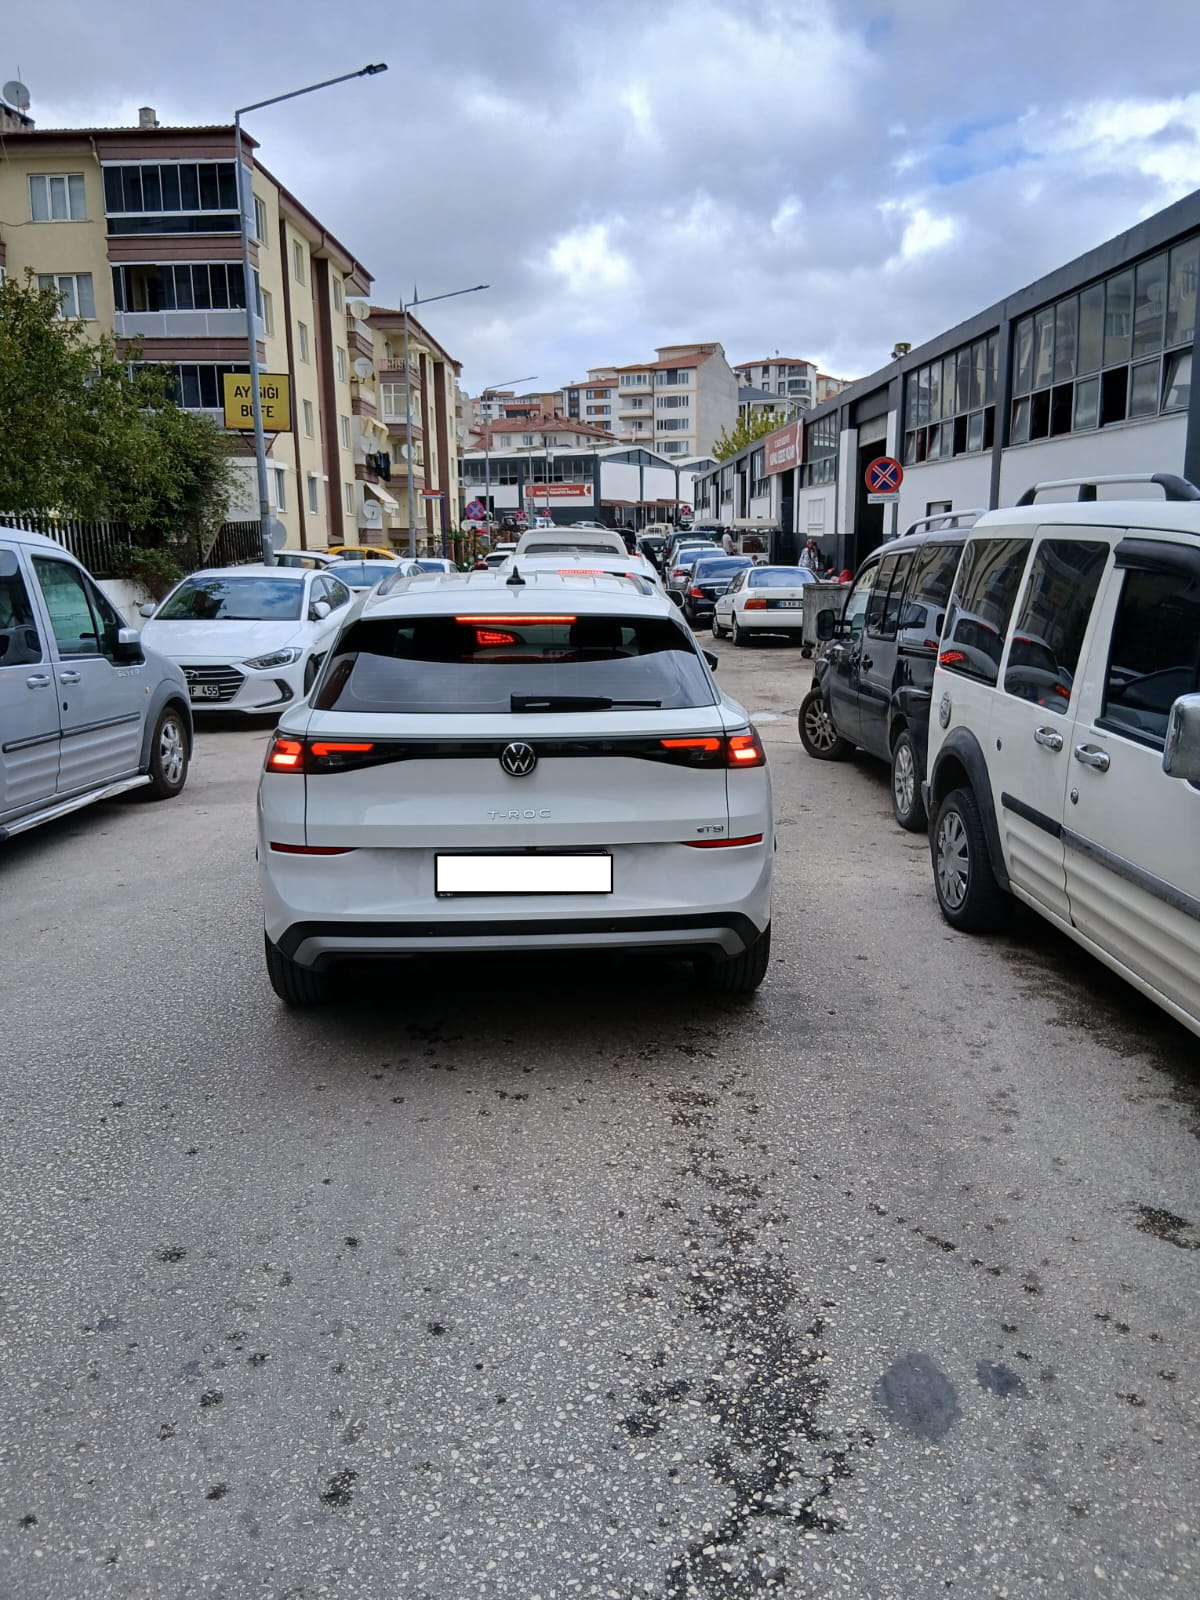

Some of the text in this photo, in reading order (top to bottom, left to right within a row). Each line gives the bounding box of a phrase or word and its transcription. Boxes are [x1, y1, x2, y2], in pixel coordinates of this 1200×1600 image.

[234, 384, 279, 399] AYIĞI
[202, 686, 218, 696] 455
[488, 809, 551, 820] T-ROC
